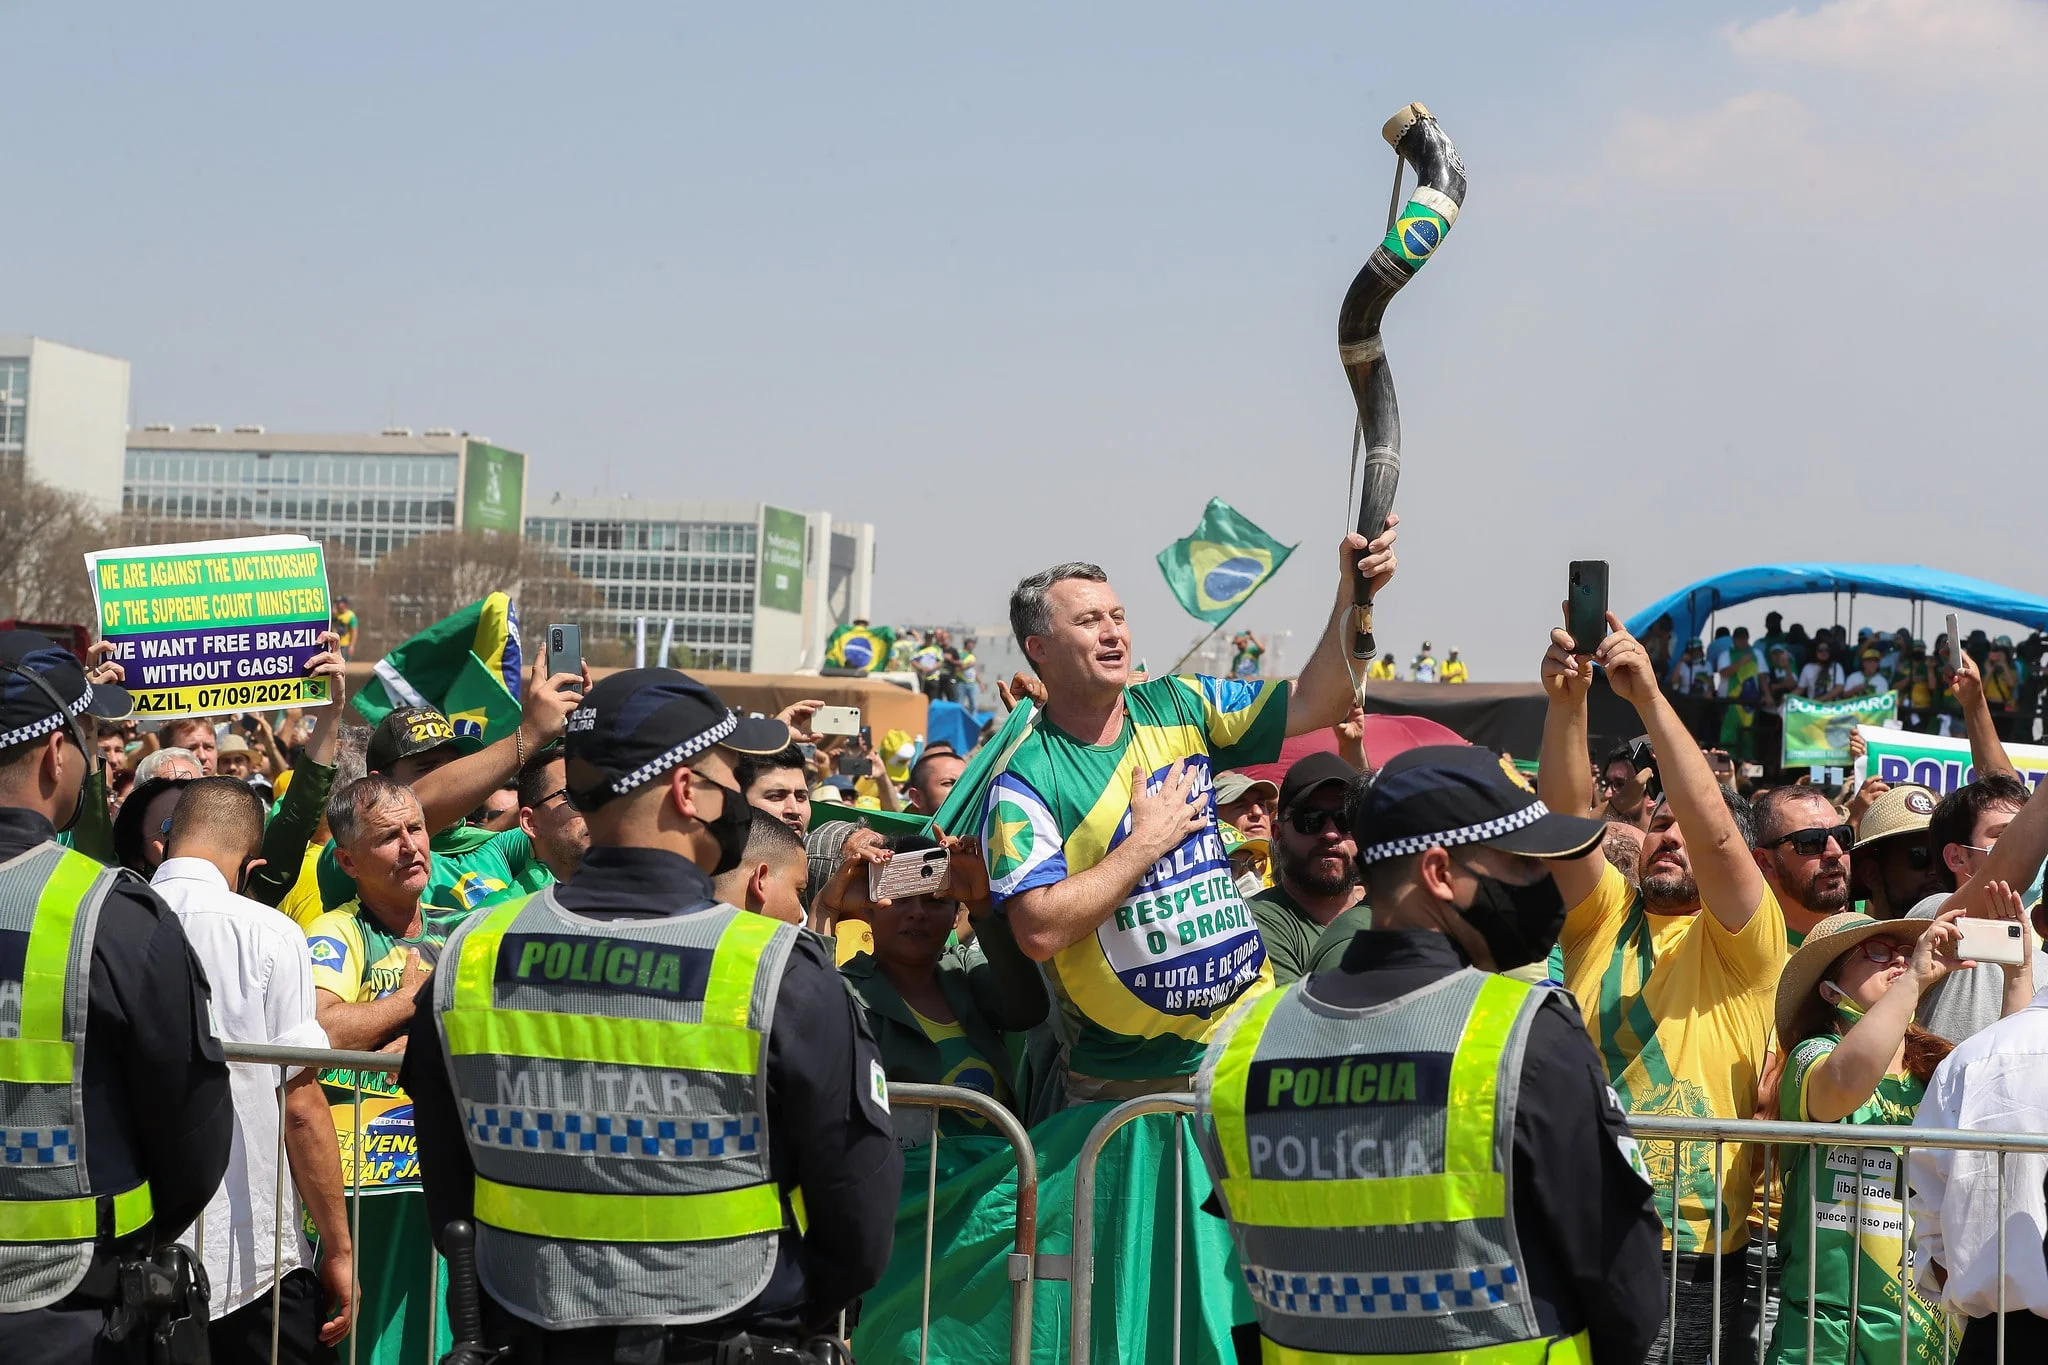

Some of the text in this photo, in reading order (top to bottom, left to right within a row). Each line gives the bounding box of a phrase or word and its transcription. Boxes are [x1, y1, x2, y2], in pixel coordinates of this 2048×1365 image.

[100, 552, 318, 590] WE ARE AGAINST THE DICTATORSHIP
[104, 588, 325, 627] OF THE SUPREME COURT MINISTERS!
[105, 642, 136, 660] WE
[140, 637, 197, 659] WANT
[203, 633, 250, 655] FREE
[142, 656, 294, 684] WITHOUT GAGS!
[129, 682, 301, 713] AZIL, 07/09/2021
[1787, 694, 1894, 714] BOLSONARO
[412, 722, 456, 742] 202
[1147, 903, 1248, 954] O BRASIL
[516, 939, 681, 993] POLÍCIA
[1135, 973, 1146, 987] A
[1154, 965, 1198, 988] LUTA
[1206, 957, 1214, 982] É
[1219, 957, 1231, 978] DE
[1166, 990, 1182, 1009] AS
[496, 1069, 693, 1113] MILITAR
[1267, 1058, 1416, 1107] POLÍCIA
[1250, 1130, 1431, 1178] POLÍCIA
[1828, 1153, 1836, 1162] A
[1878, 1158, 1892, 1170] da
[1836, 1181, 1891, 1199] libedade
[1816, 1212, 1903, 1232] quece nsso peit
